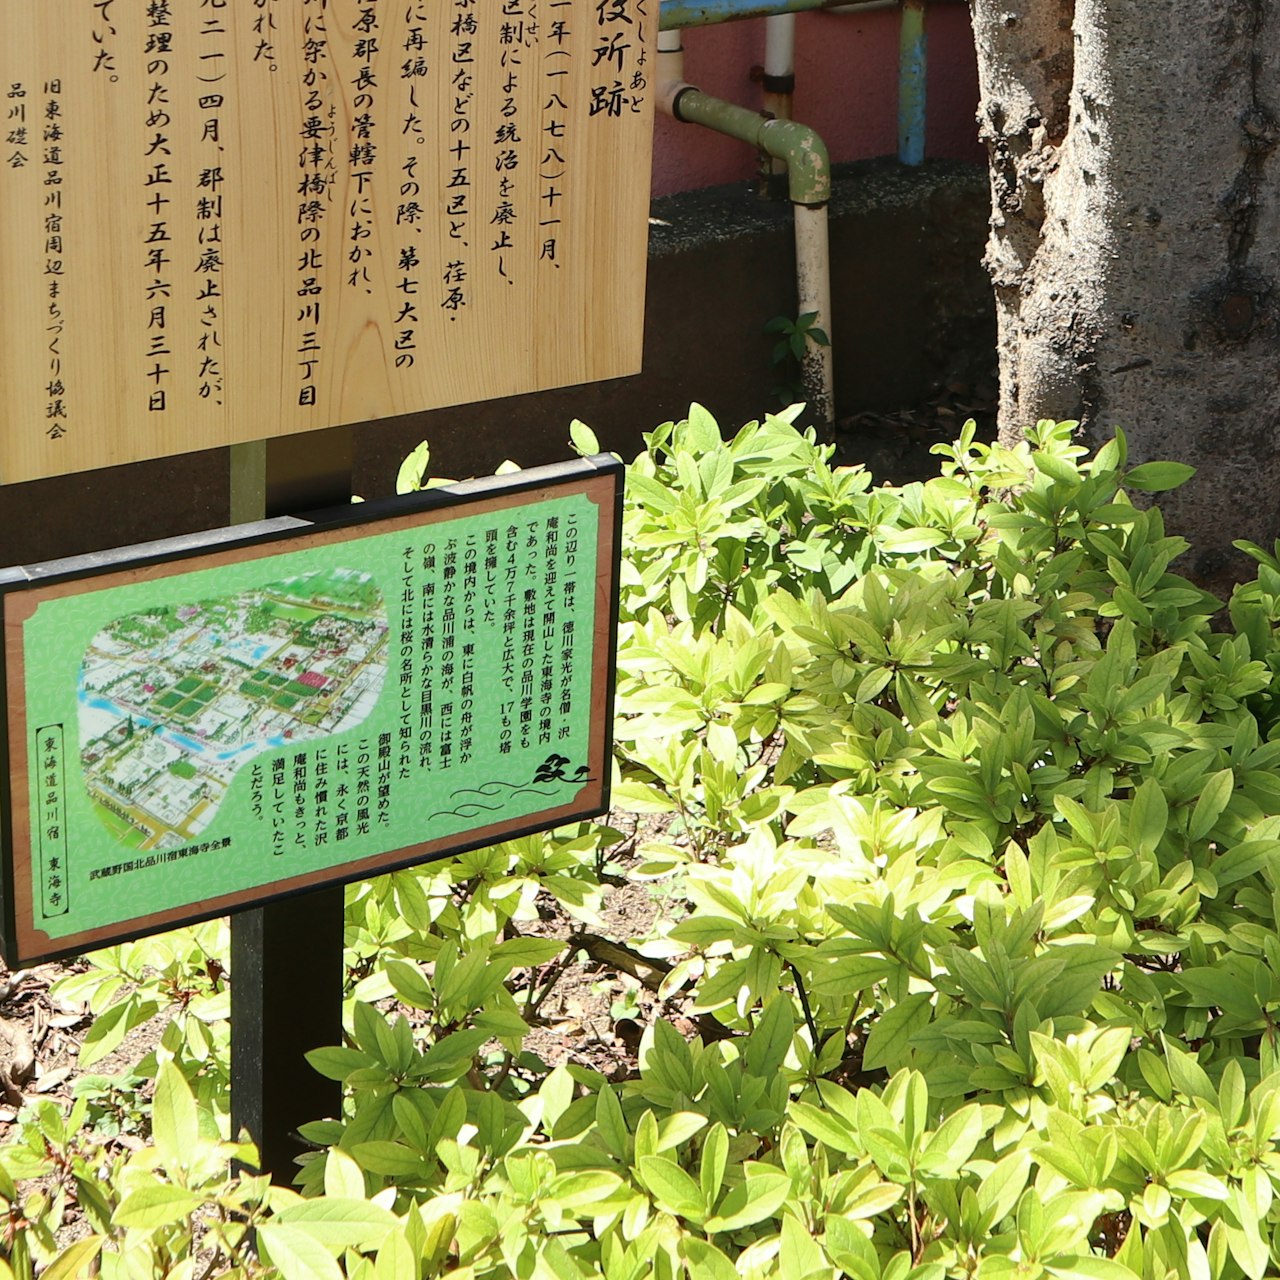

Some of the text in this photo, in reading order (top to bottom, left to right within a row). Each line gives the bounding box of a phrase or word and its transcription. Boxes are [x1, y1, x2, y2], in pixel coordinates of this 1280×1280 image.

[5, 82, 29, 169] 品川礎会
[324, 103, 338, 203] ようじんばし
[42, 78, 68, 440] 旧東海道品川宿周辺まちづくり協議会
[483, 527, 499, 628] 頭を擁していた。
[398, 546, 415, 780] そして北には桜の名所として知られた
[418, 543, 436, 773] の嶺、南には水清らかな目黒川の流れ、
[439, 538, 458, 770] ぶ波静かな品川浦の海が、西には富士
[459, 534, 478, 764] この境内からは、東に白帆の舟が浮か
[519, 520, 539, 749] であった。敷地は現在の品川学園をも
[538, 516, 559, 746] 庵和尚を迎えて開山した東海寺の境内
[43, 736, 62, 907] 東海道品川宿 東海寺
[250, 763, 264, 821] とだろう。
[271, 757, 286, 856] 満足していたこ
[292, 752, 307, 849] 庵和尚もきっと、
[314, 748, 329, 847] に住み慣れた沢
[335, 743, 350, 842] には、永く京都
[355, 738, 371, 837] この天然の風光
[377, 731, 392, 828] 御殿山が望めた。
[89, 836, 232, 881] 武蔵野国北品川宿東海寺全景
